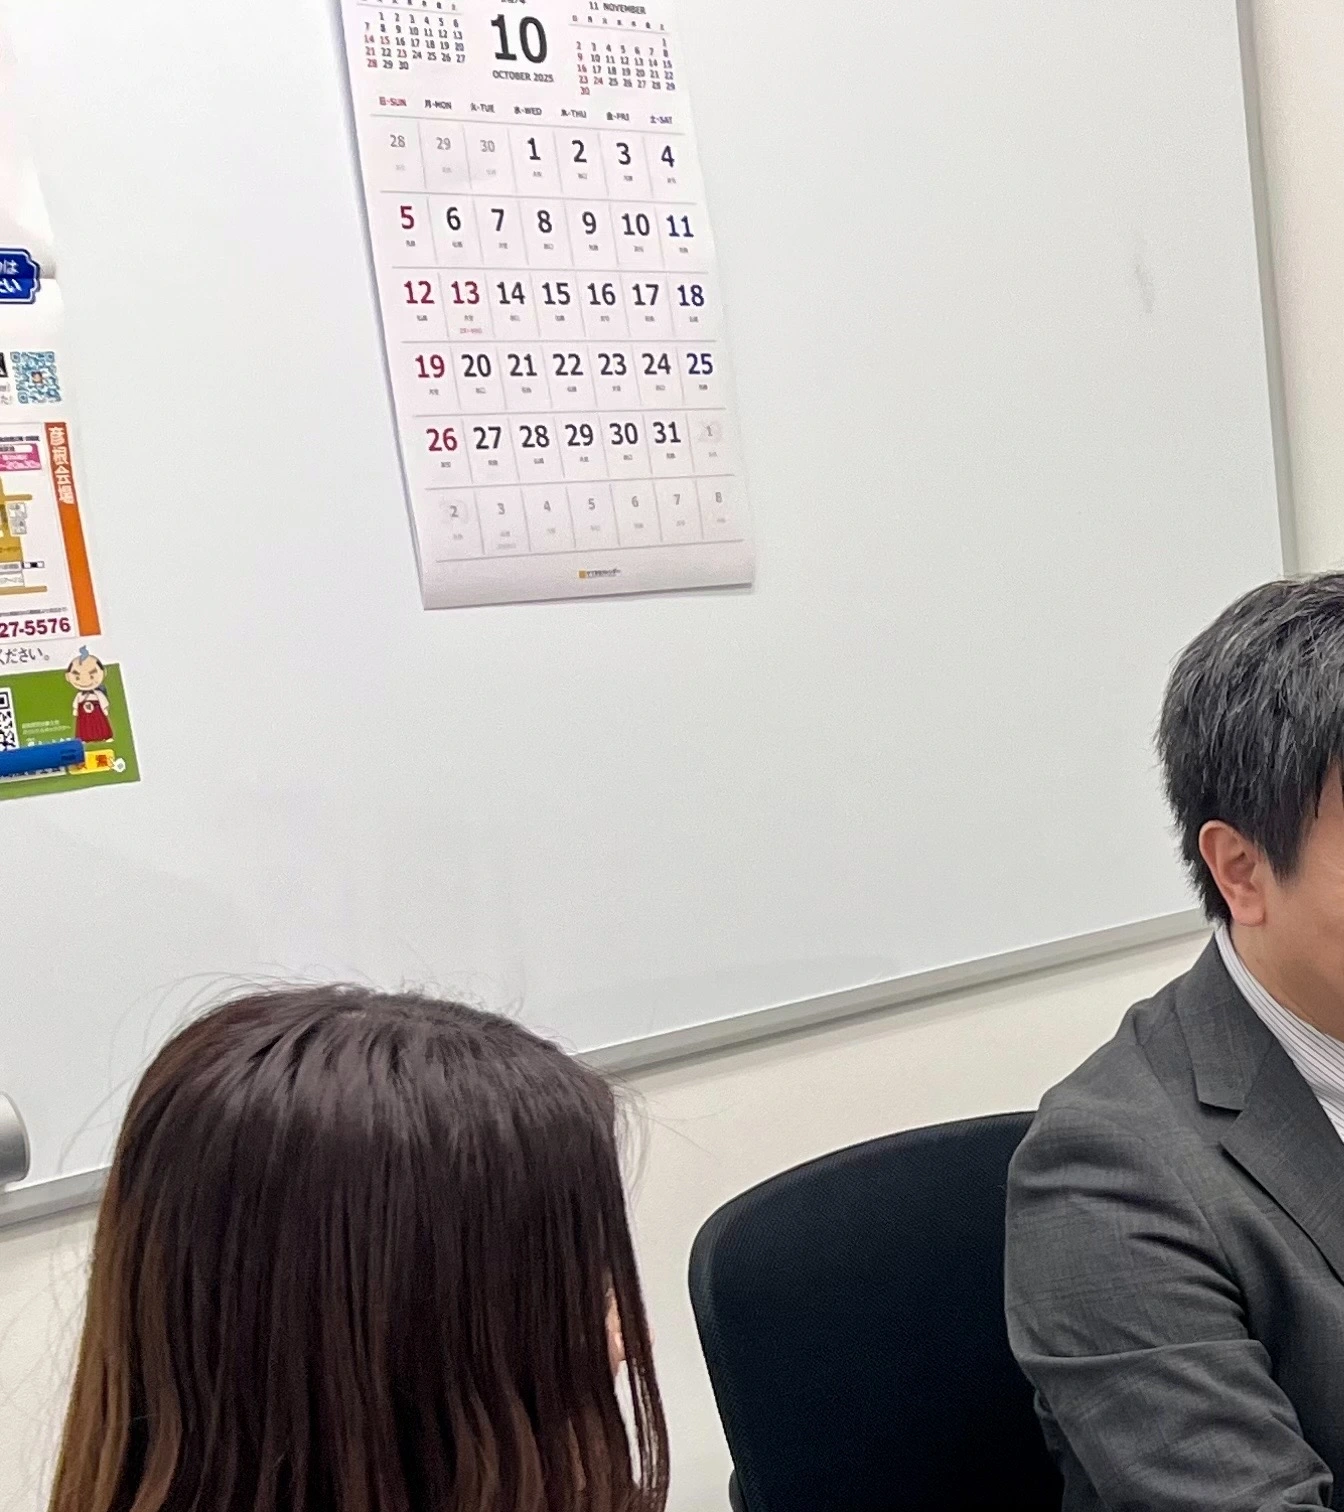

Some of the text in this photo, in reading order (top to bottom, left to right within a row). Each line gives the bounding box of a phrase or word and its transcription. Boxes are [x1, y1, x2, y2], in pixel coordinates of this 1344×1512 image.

[589, 1, 646, 14] 11 NOVEMBER
[379, 12, 384, 20] 1
[395, 13, 400, 22] 2
[409, 14, 415, 23] 3
[439, 17, 444, 26] 5
[453, 19, 459, 27] 6
[364, 22, 462, 39] 7 8 9 10 11 12 13
[491, 14, 547, 63] 10
[364, 35, 464, 51] 14 15 16 17 18 19 20
[576, 41, 581, 50] 2
[591, 42, 596, 51] 3
[606, 44, 611, 52] 4
[620, 45, 626, 53] 5
[663, 49, 668, 57] 8
[662, 38, 666, 47] 1
[366, 47, 465, 63] 21 22 23 24 25 26 27
[578, 53, 672, 68] 9 10 11 12 13 14 15
[367, 59, 409, 70] 28 29 30
[577, 64, 673, 79] 16 17 18 19 20 21 22
[493, 70, 554, 82] OCTOBER 2025
[579, 76, 675, 90] 23 24 25 26 27 28 29
[580, 87, 590, 95] 30
[390, 135, 674, 167] 28 29 30 1 2 3 4
[401, 206, 694, 237] 5 6 7 8 9 10 11
[404, 281, 704, 306] 12 13 14 15 16 17 18
[416, 353, 713, 378] 19 20 21 22 23 24 25
[426, 422, 713, 451] 26 27 28 29 30 31 1
[450, 492, 722, 517] 2 3 4 5 6 7 8
